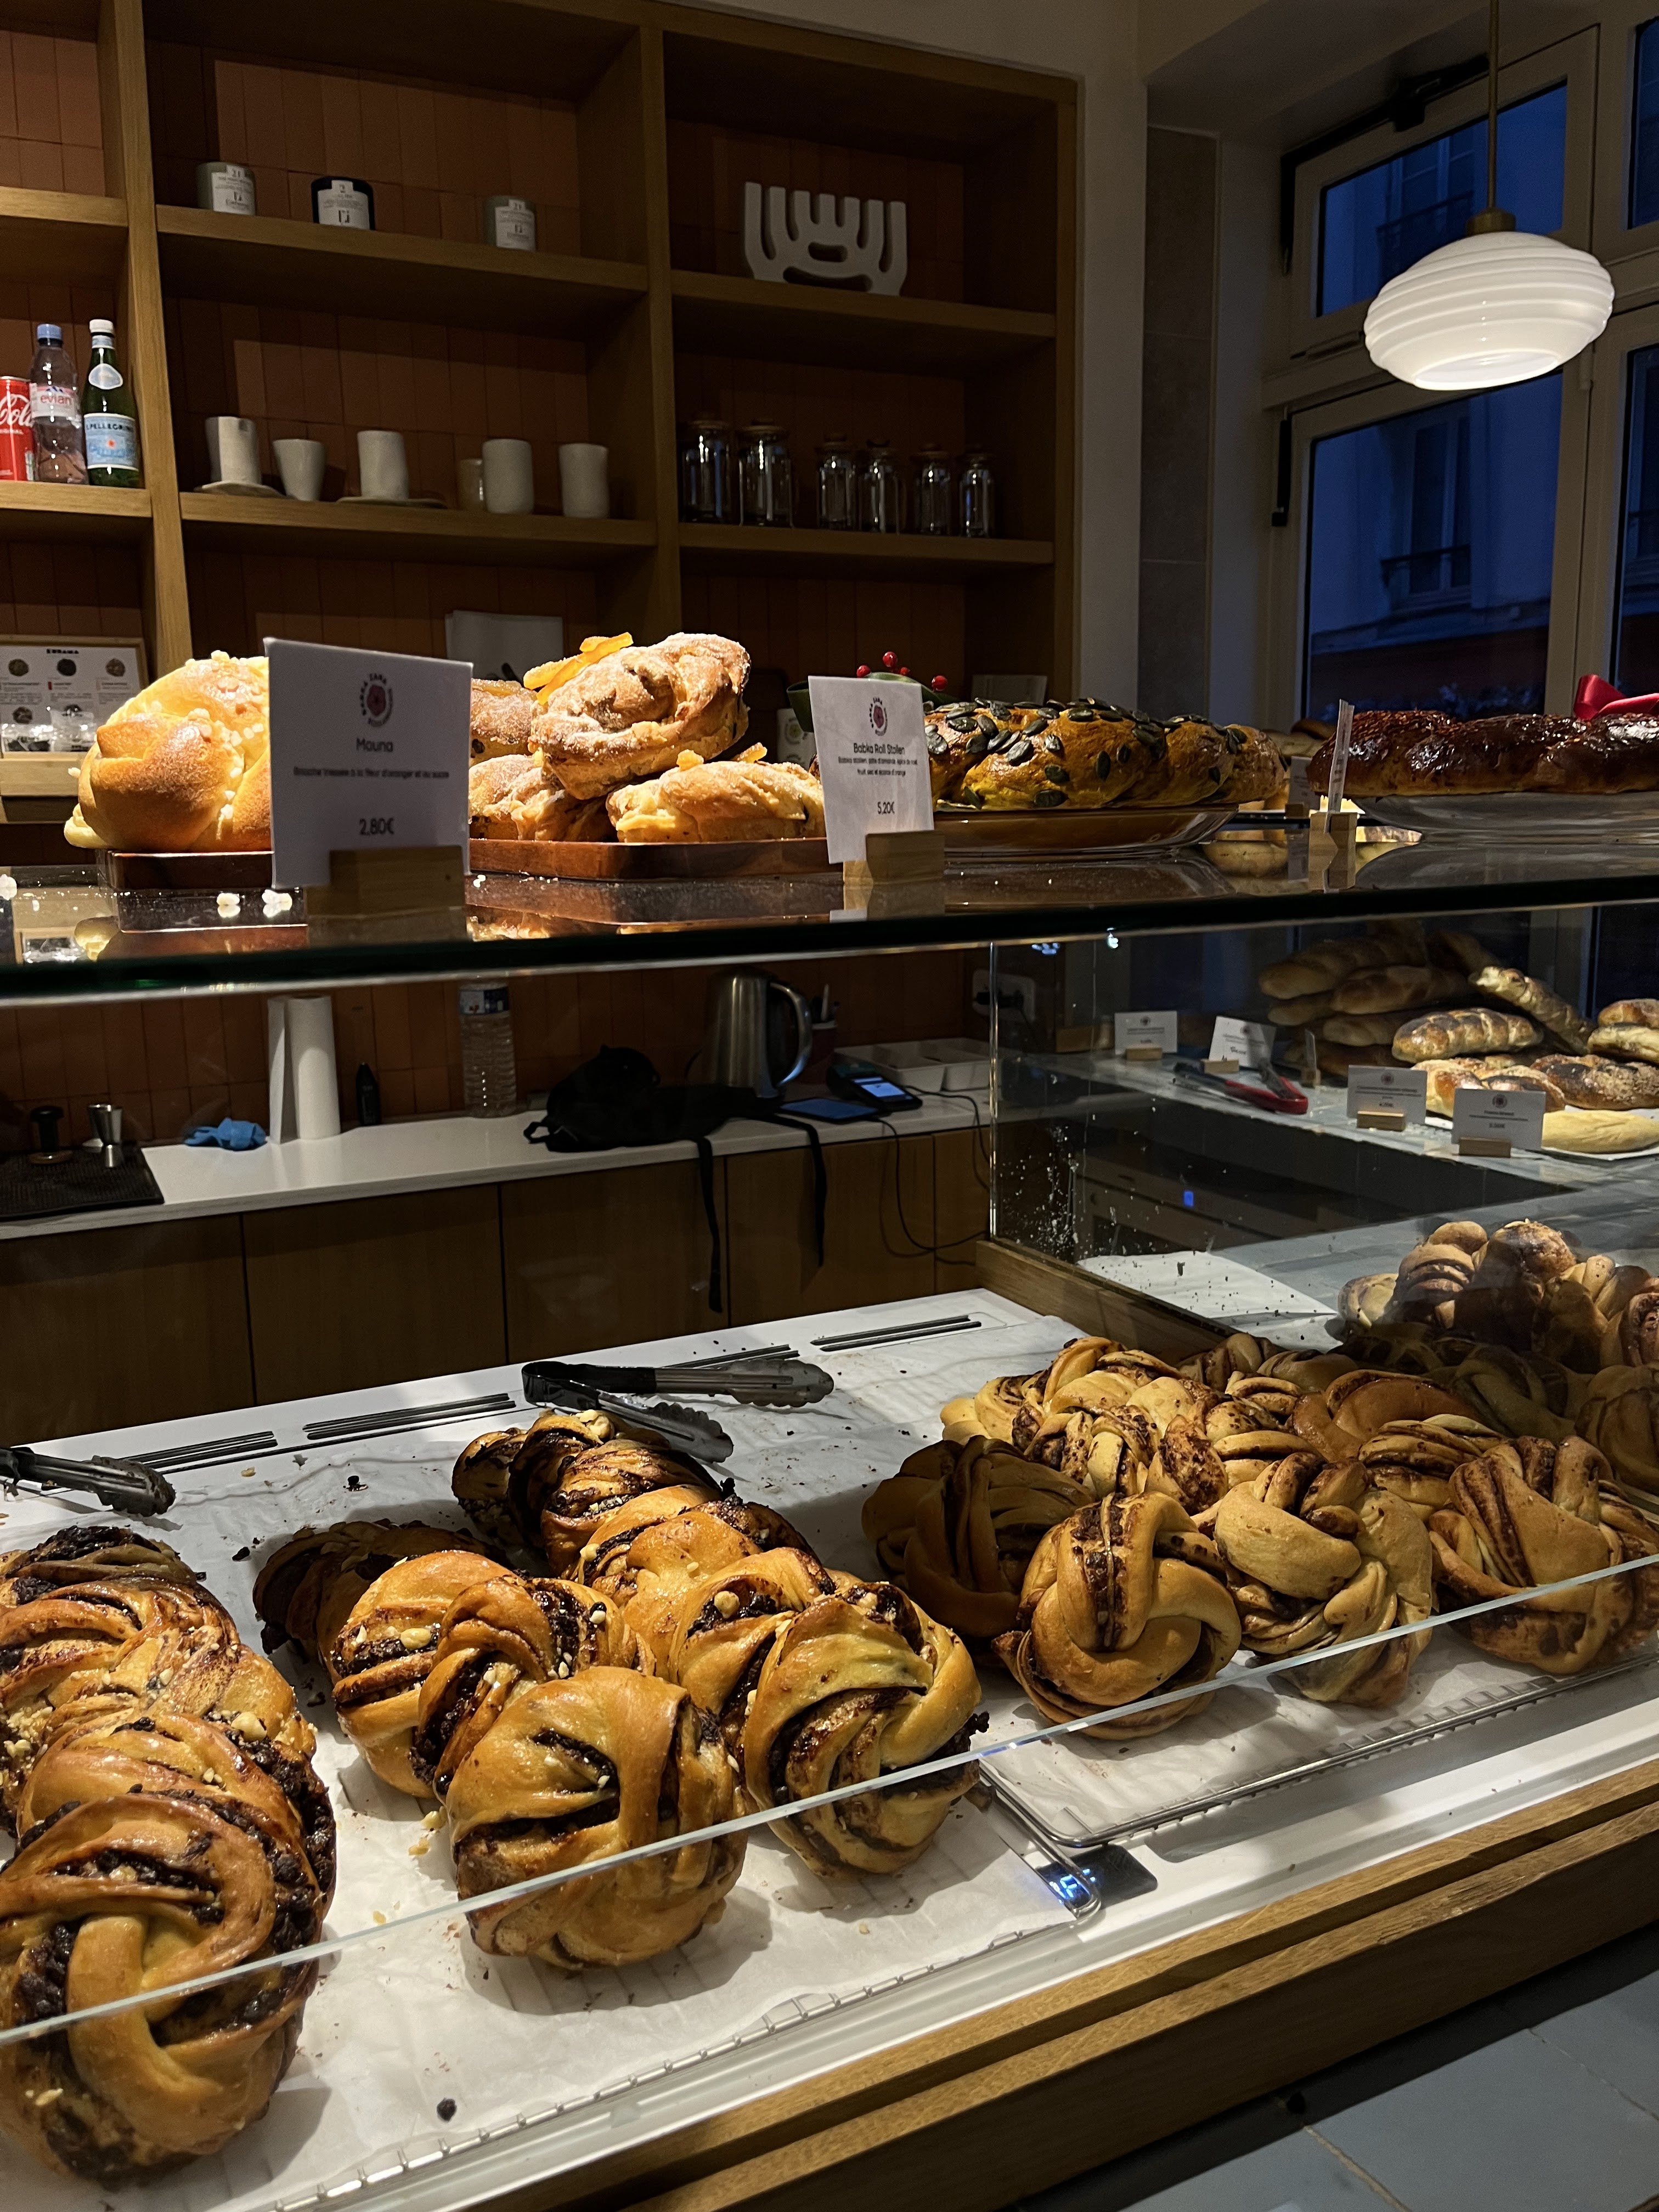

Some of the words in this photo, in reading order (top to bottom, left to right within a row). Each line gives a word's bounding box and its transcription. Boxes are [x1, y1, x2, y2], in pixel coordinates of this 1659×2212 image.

[41, 394, 72, 405] evian
[356, 737, 394, 753] Mouna
[854, 743, 873, 753] Babka
[874, 743, 886, 754] Roll
[887, 744, 905, 754] Stollen
